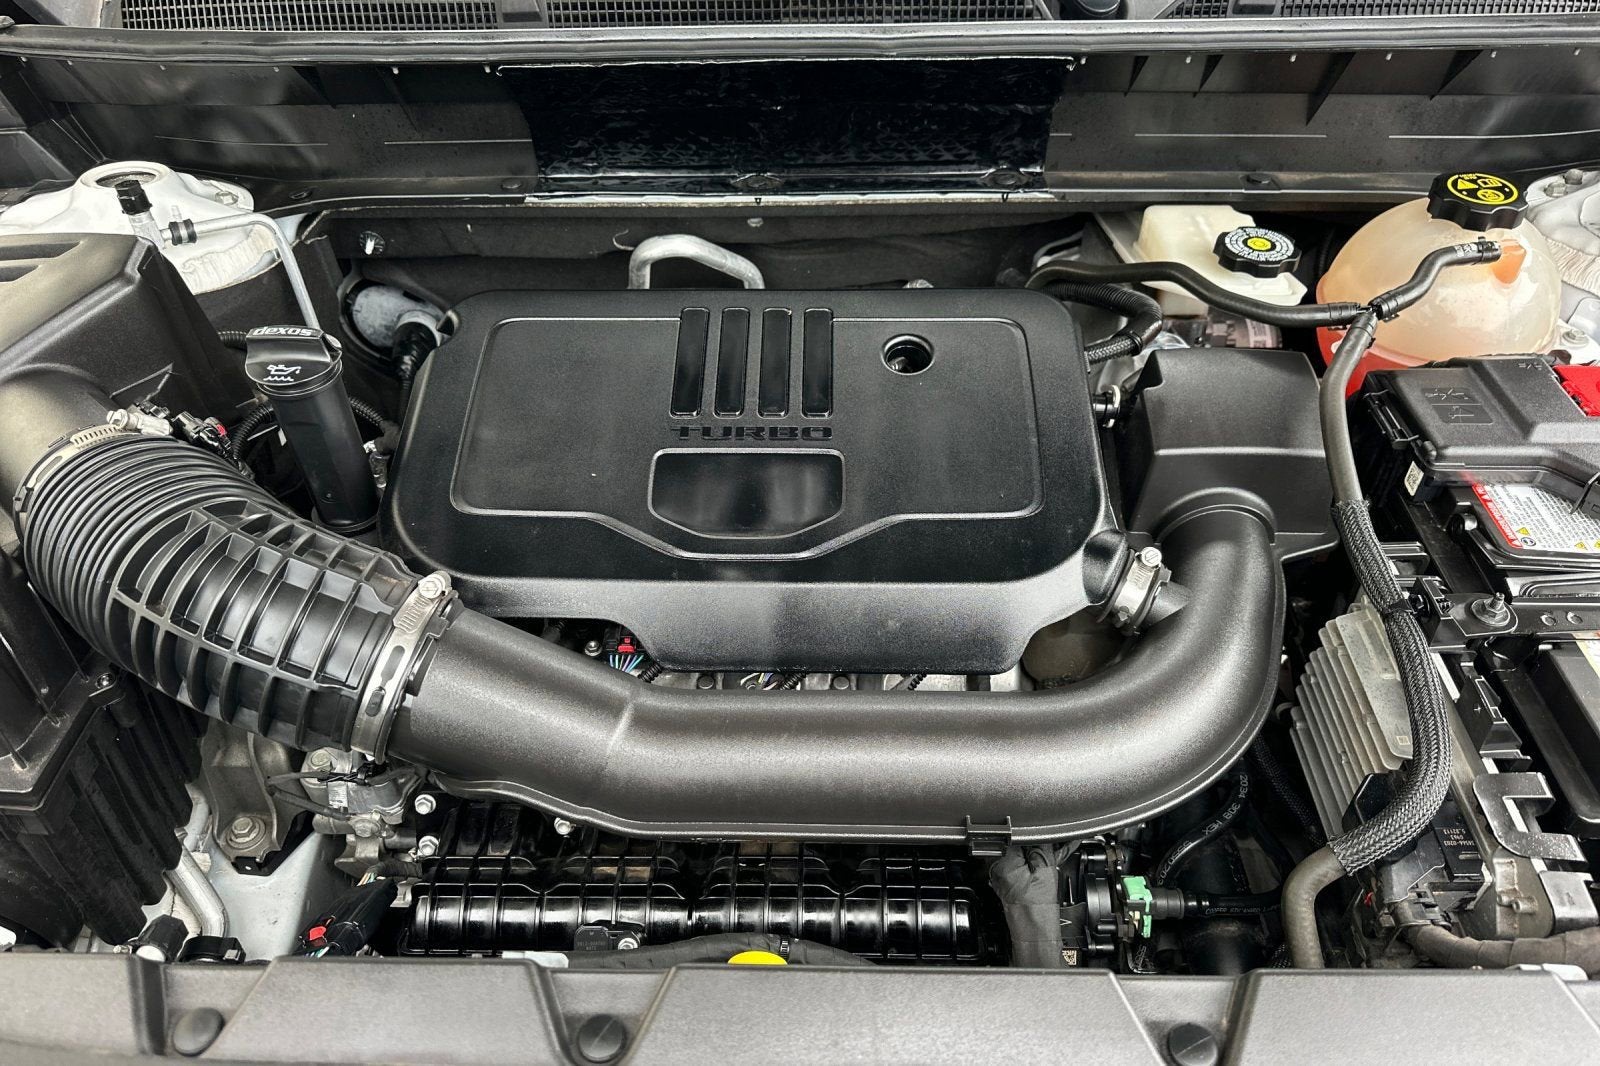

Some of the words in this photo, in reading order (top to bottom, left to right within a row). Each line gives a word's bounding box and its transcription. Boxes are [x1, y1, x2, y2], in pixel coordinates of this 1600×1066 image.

[252, 326, 313, 337] dexos
[670, 426, 833, 441] TURBO
[1238, 774, 1249, 799] 2034
[1223, 802, 1241, 820] 308
[1202, 818, 1223, 836] MEX
